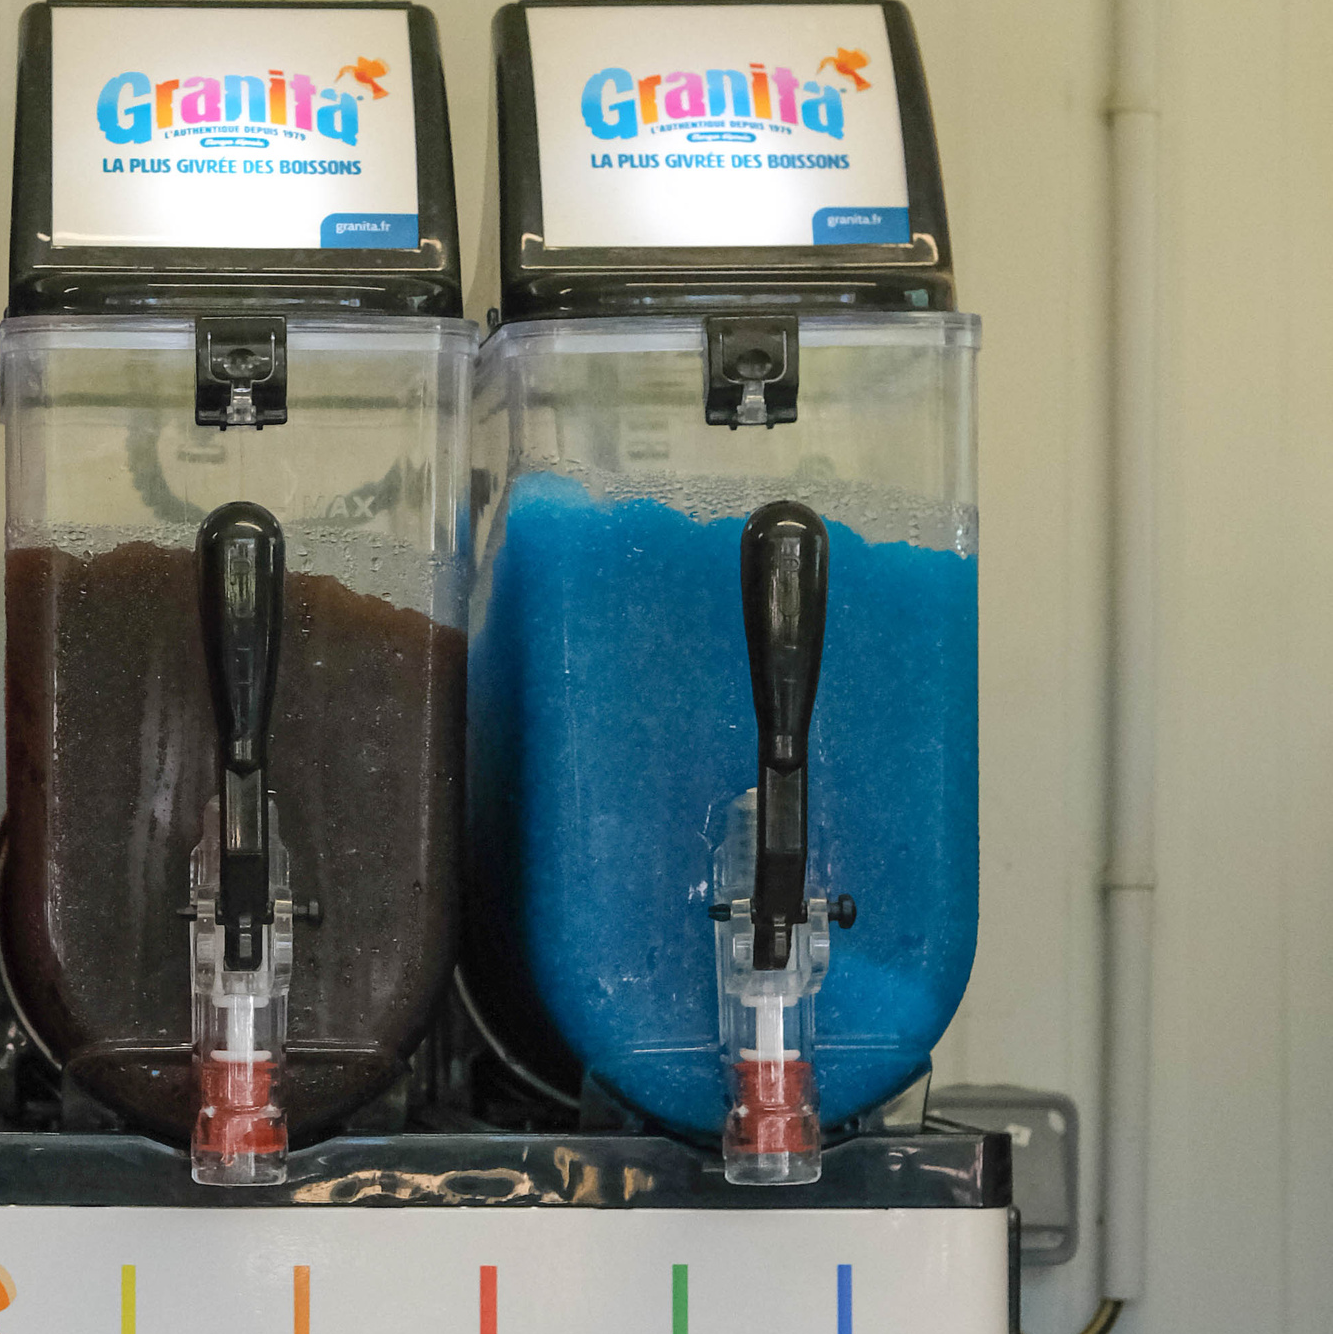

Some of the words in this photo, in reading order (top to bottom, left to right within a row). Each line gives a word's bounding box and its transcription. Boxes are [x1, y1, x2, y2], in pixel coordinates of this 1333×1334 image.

[97, 70, 359, 146] Granita
[581, 63, 845, 140] Granita
[244, 126, 278, 136] DEPUIS
[283, 130, 306, 141] 1979
[103, 158, 124, 173] LA
[130, 159, 171, 174] PLUS
[176, 157, 237, 174] GIVRÉE
[243, 160, 274, 174] DES
[279, 159, 362, 176] BOISSONS
[591, 154, 612, 168] LA
[618, 154, 659, 168] PLUS
[665, 151, 725, 168] GIVRÉE
[731, 154, 762, 169] DES
[768, 154, 850, 170] BOISSONS
[336, 220, 391, 234] granita.fr
[826, 213, 882, 227] granita.fr
